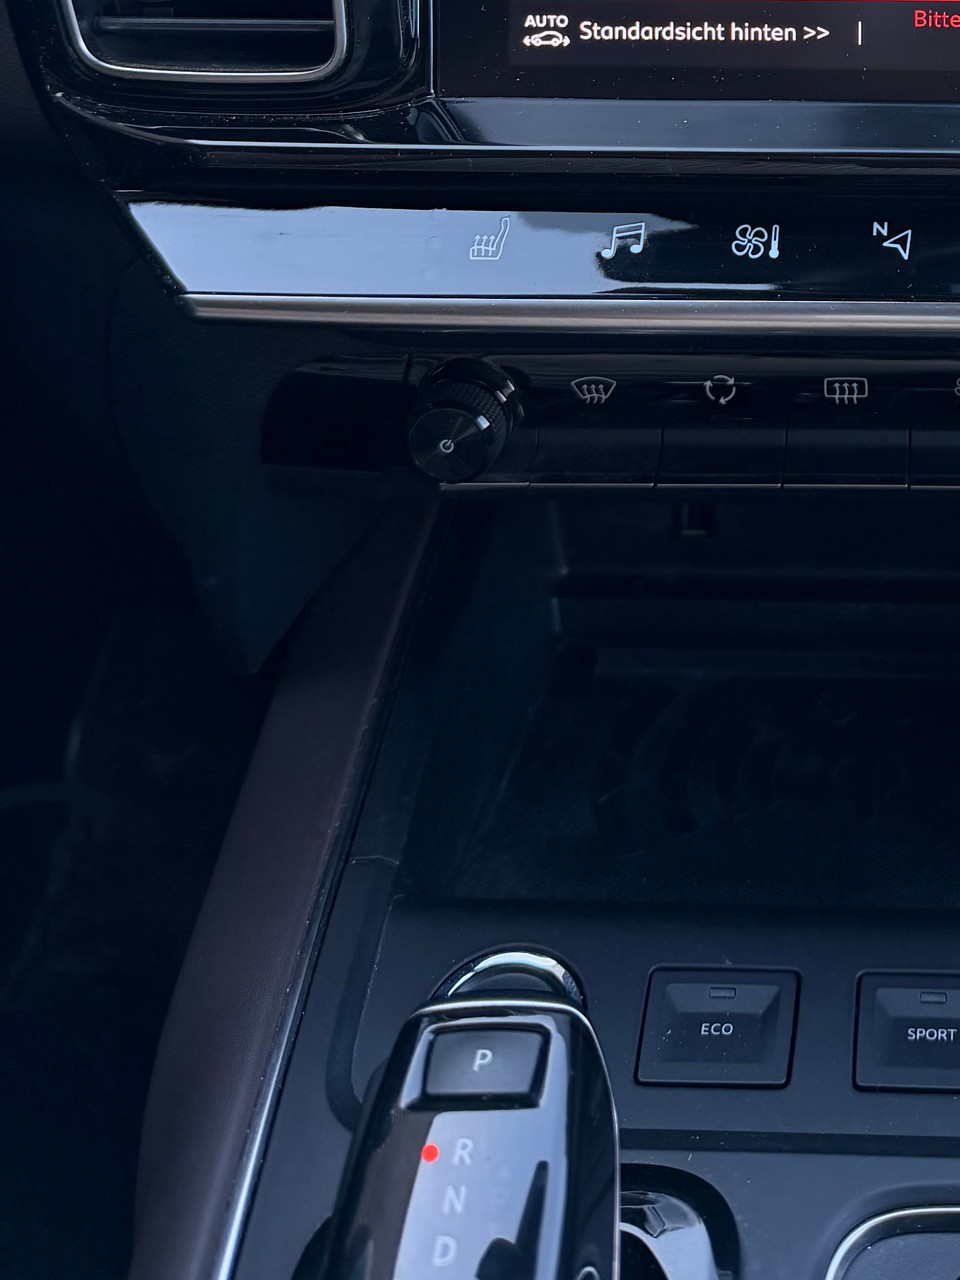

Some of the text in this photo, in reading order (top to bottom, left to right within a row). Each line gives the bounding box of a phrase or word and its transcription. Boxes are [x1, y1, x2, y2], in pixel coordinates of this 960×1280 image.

[524, 14, 569, 28] AUTO
[579, 21, 726, 41] Standardsicht
[730, 22, 797, 42] hinten
[700, 1023, 734, 1036] ECO
[907, 1028, 957, 1041] SPORT
[472, 1049, 493, 1072] P
[453, 1138, 474, 1166] R
[442, 1184, 467, 1215] N
[432, 1235, 459, 1267] D
